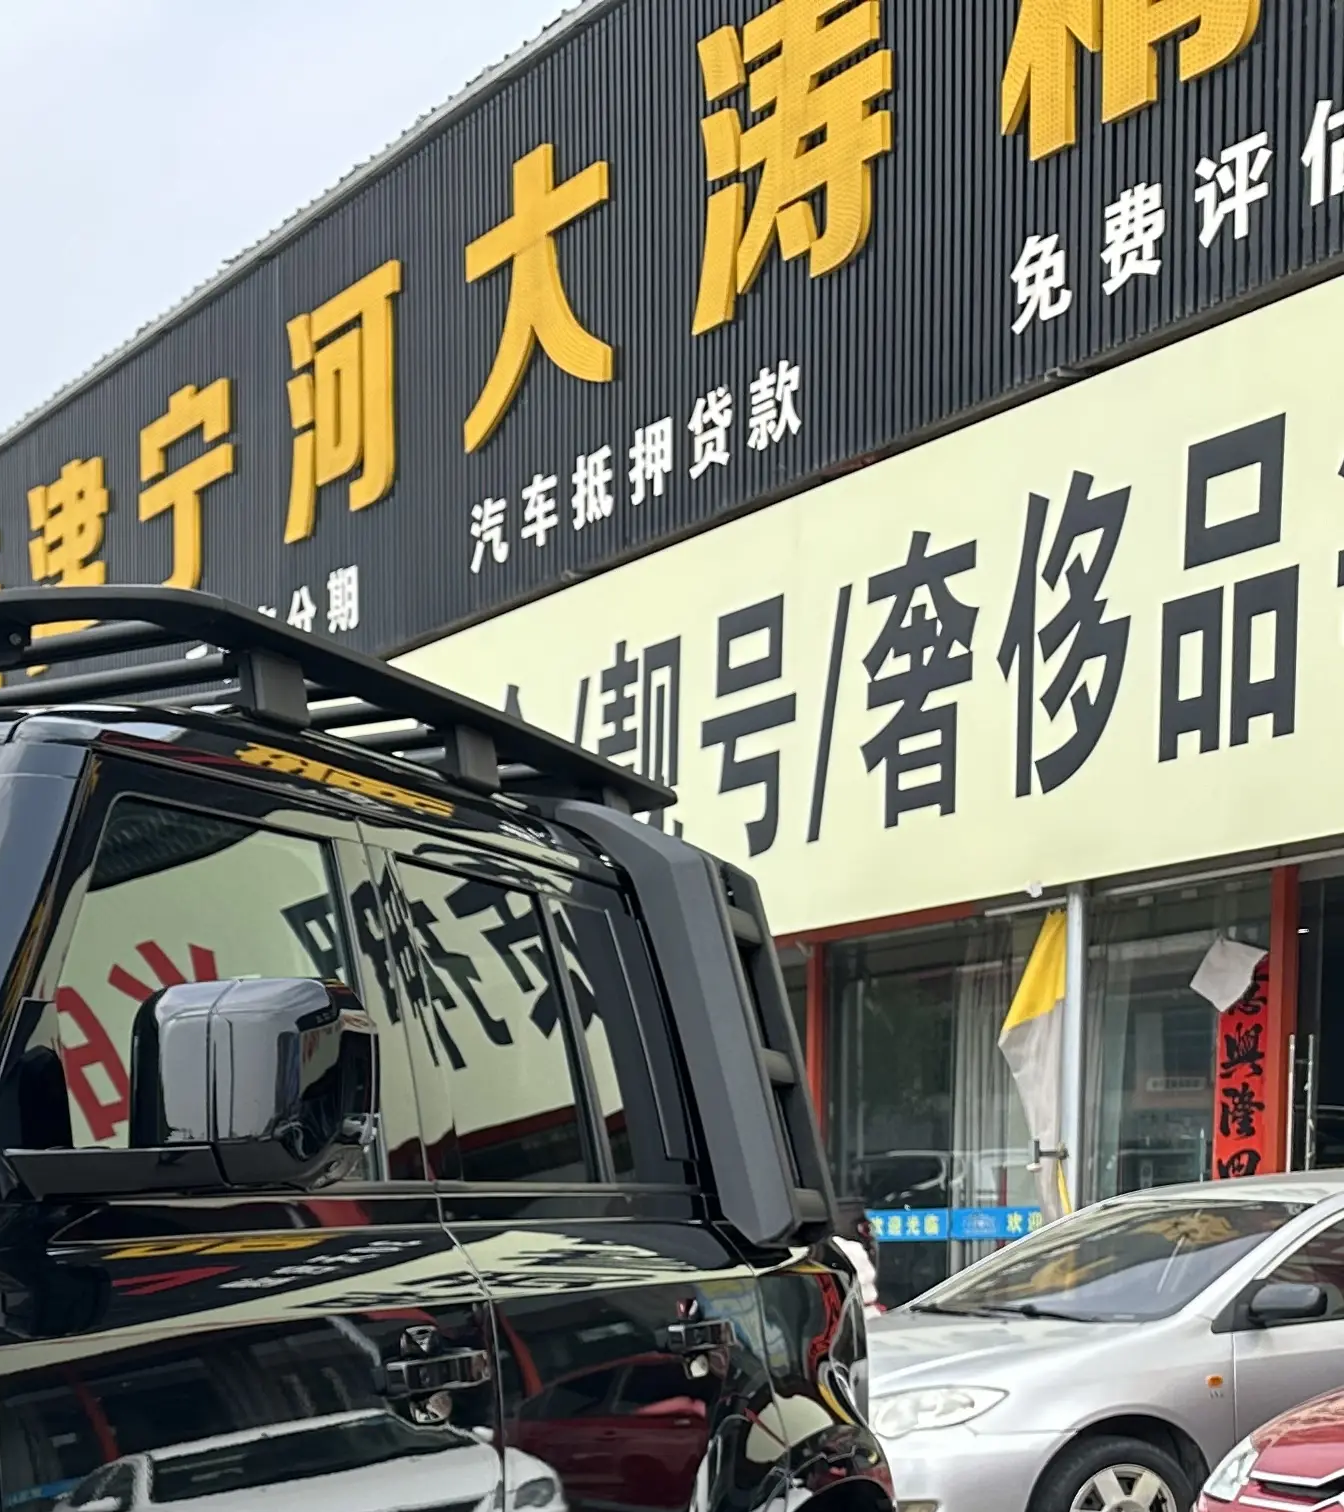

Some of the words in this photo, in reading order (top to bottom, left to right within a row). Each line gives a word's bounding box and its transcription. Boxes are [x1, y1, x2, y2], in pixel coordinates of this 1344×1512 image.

[468, 359, 803, 574] 汽车抵押贷款
[257, 564, 359, 634] 分期
[505, 411, 1344, 858] /靓号/奢侈品
